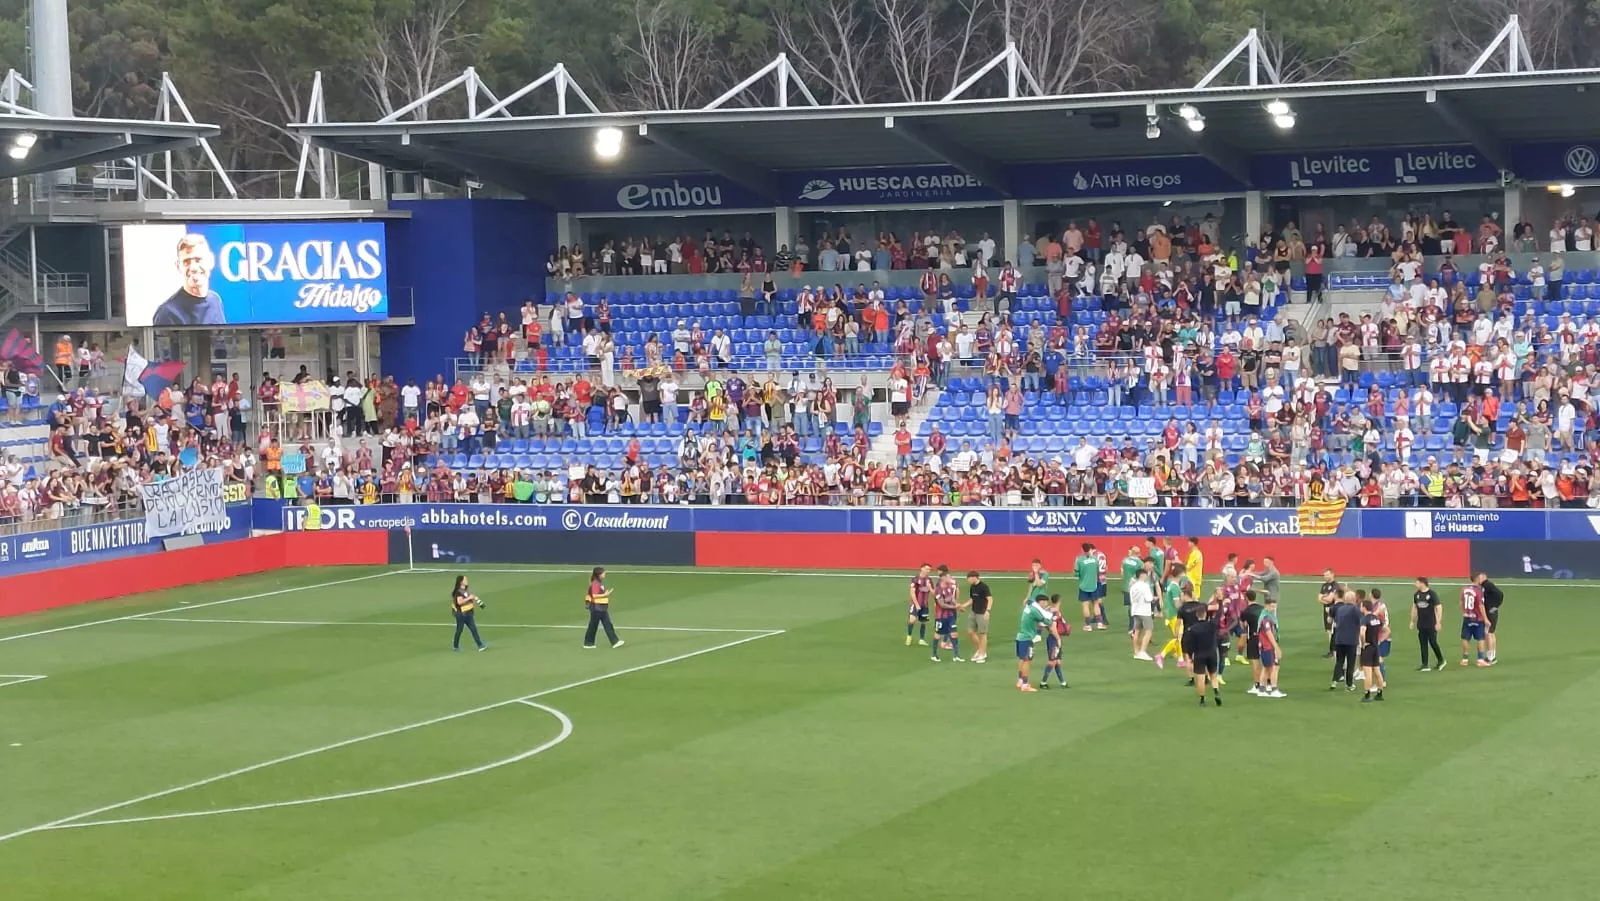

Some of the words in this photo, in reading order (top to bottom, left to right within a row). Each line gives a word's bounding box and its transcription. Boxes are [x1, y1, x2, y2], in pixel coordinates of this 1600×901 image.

[839, 176, 914, 191] HUESCA
[916, 174, 982, 188] GARDE
[1125, 174, 1181, 189] Riegos
[616, 179, 722, 210] embou
[219, 239, 382, 283] GRACIAS
[294, 281, 382, 314] Hidalgo
[157, 510, 177, 529] LA
[421, 508, 547, 526] abbahotels.com
[583, 511, 670, 530] Casademont
[873, 510, 986, 536] HINACO
[1237, 514, 1300, 535] CaixaB
[1434, 511, 1500, 522] Ayuntamiento
[1434, 523, 1446, 532] de
[1448, 522, 1485, 532] Huesca
